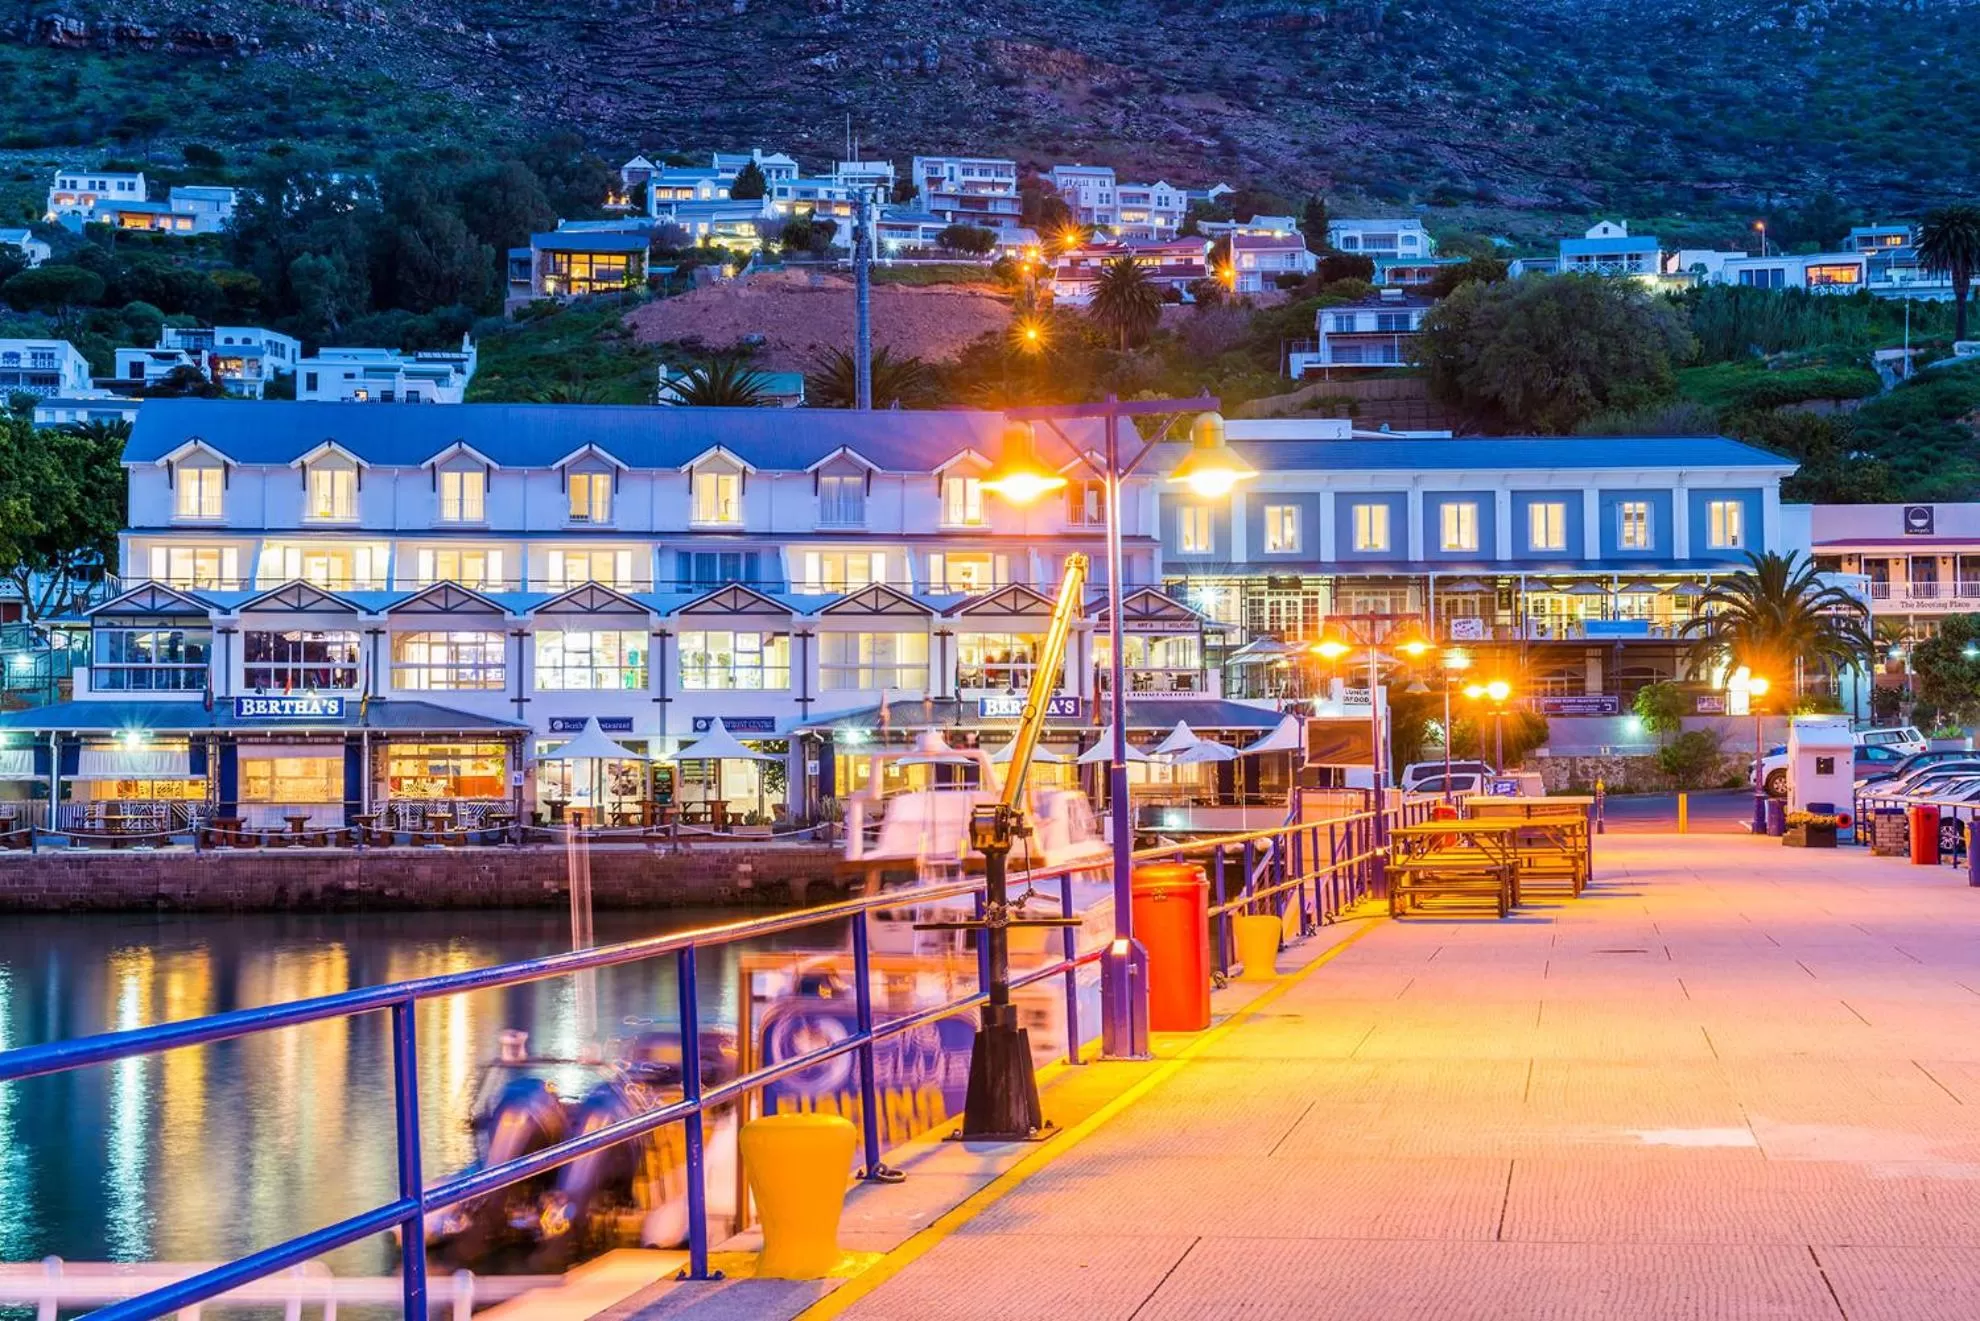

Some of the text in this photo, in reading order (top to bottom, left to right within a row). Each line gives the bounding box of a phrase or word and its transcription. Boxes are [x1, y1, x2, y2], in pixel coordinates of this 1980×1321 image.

[1900, 600, 1970, 610] The Meeting Place
[241, 699, 339, 716] BERTHA'S
[984, 700, 1075, 716] BERA'S
